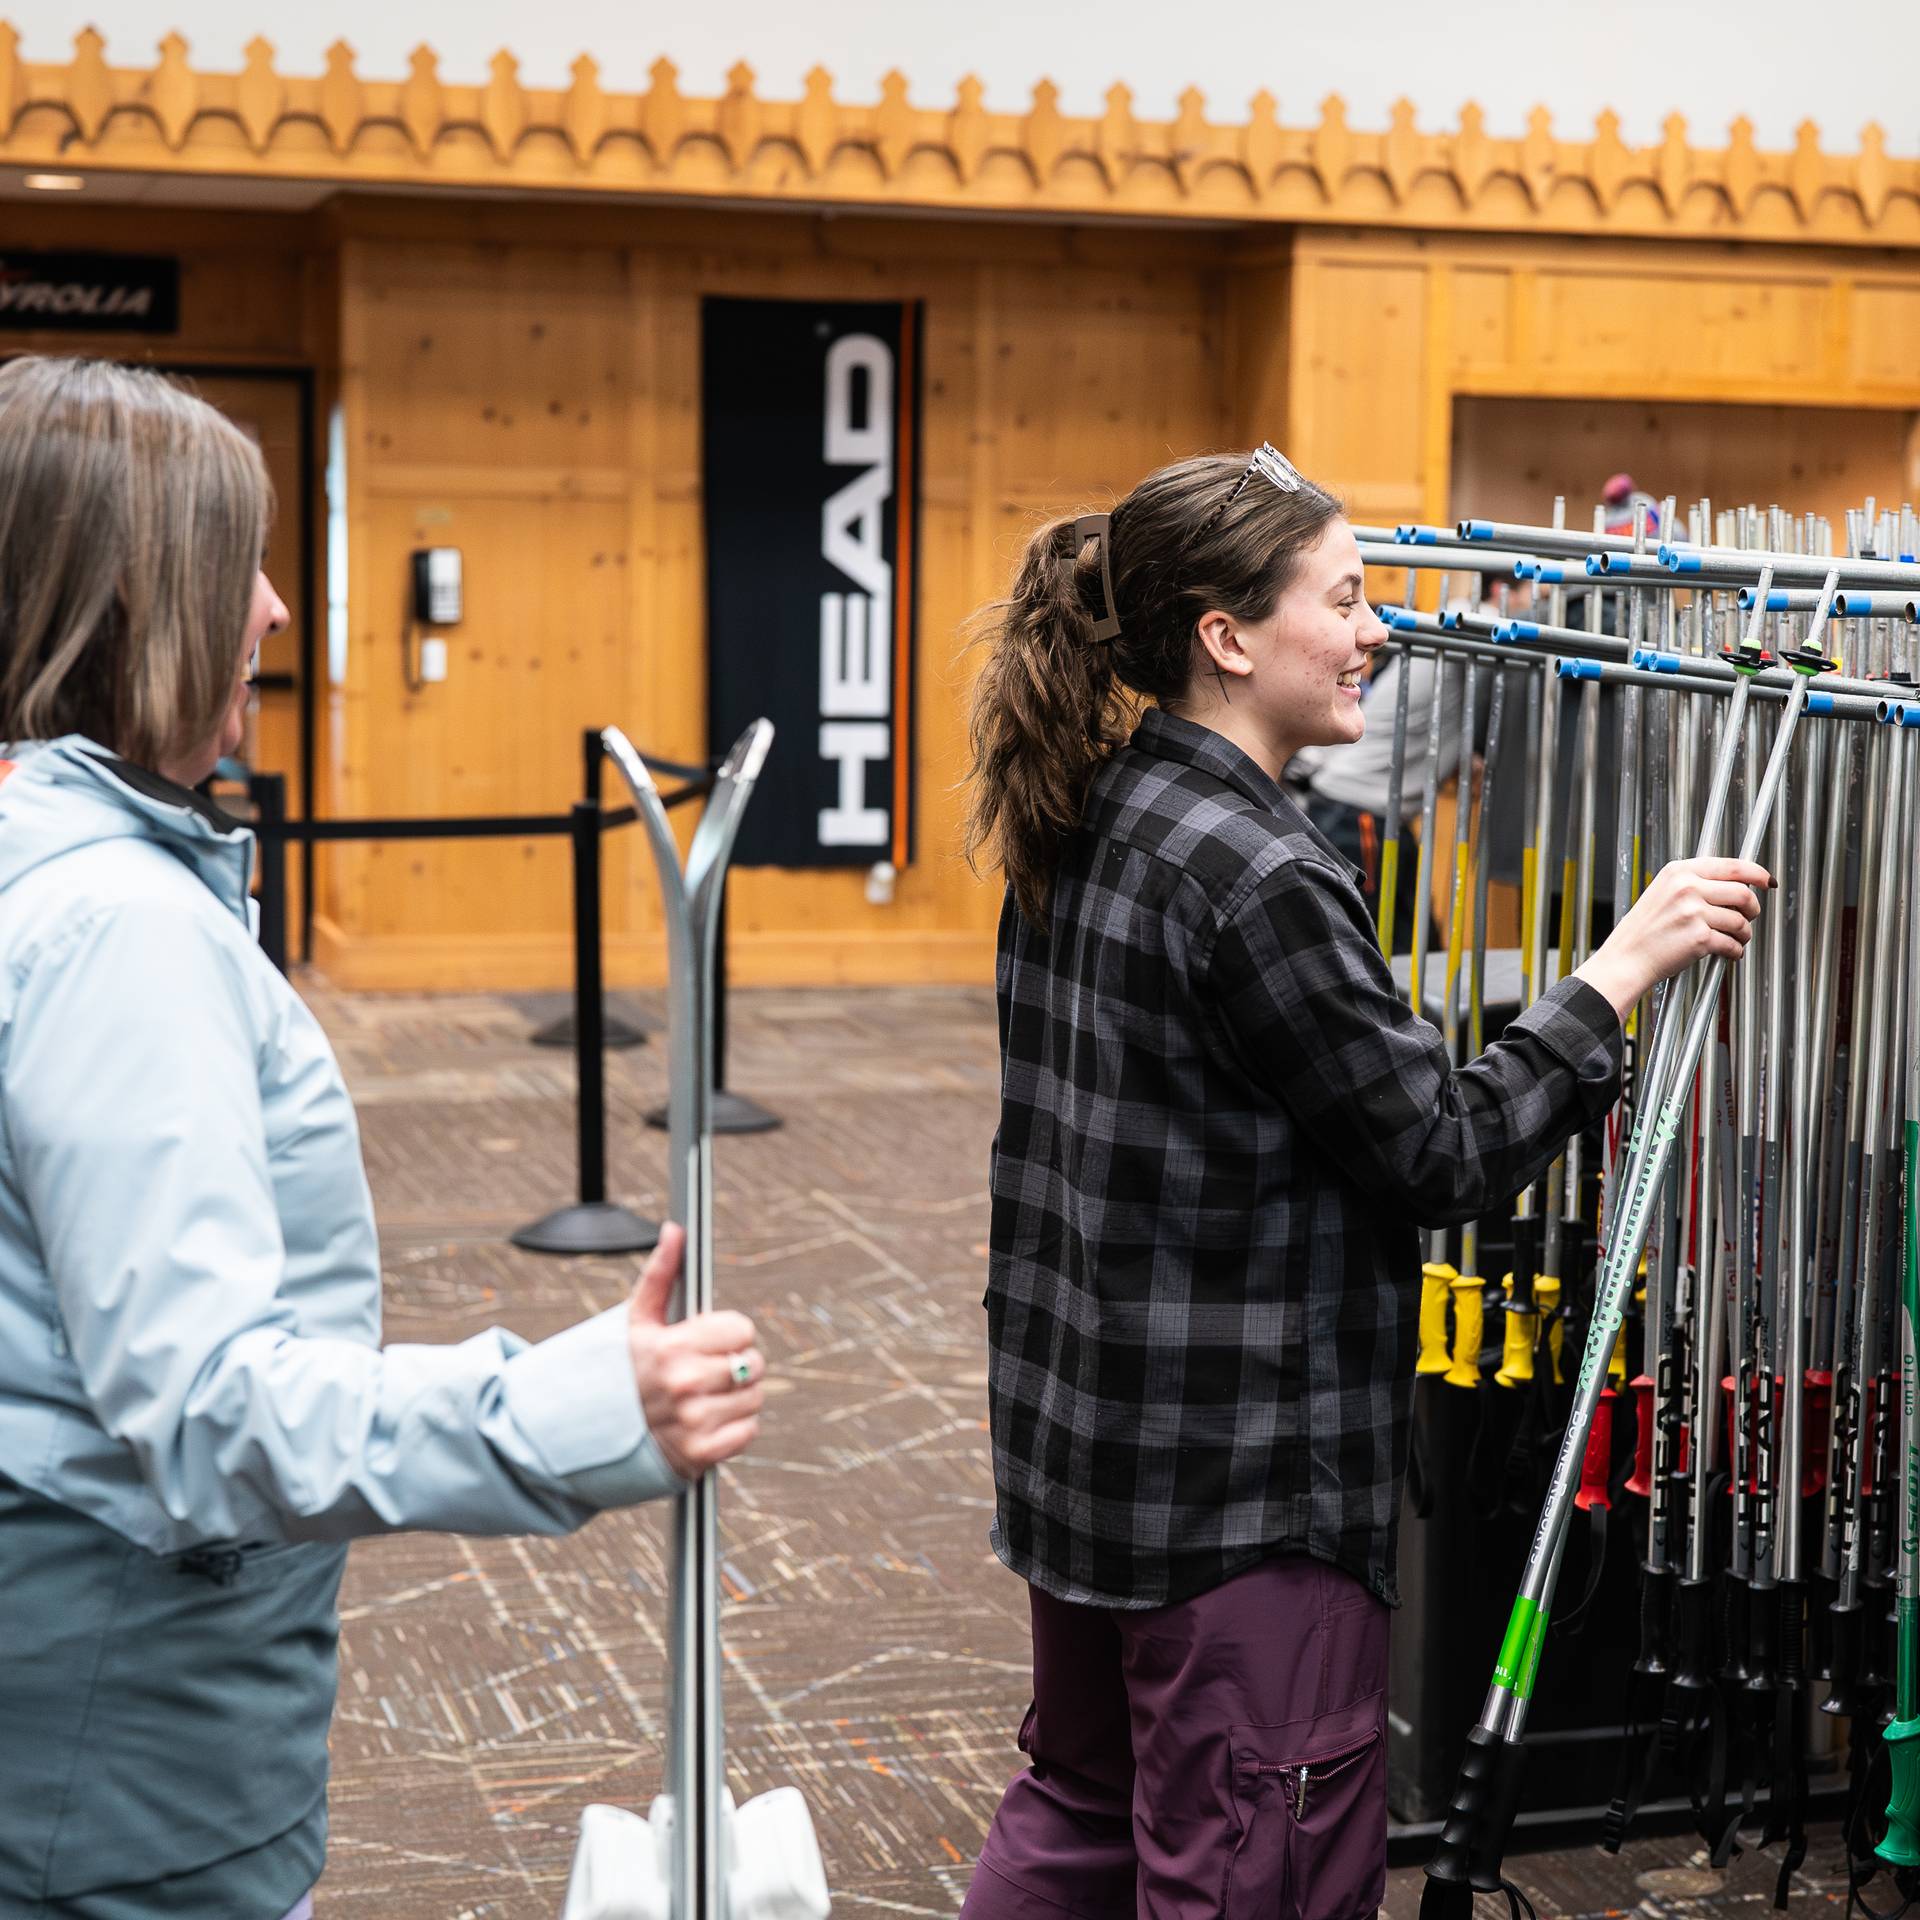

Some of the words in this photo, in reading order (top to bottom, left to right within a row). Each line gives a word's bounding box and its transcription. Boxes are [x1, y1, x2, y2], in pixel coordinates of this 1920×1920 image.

[0, 282, 153, 316] YROLIA
[818, 332, 894, 847] HEAD
[1903, 1353, 1915, 1417] cm110
[1653, 1357, 1673, 1518] HEAD
[1907, 1440, 1920, 1533] SCOTT
